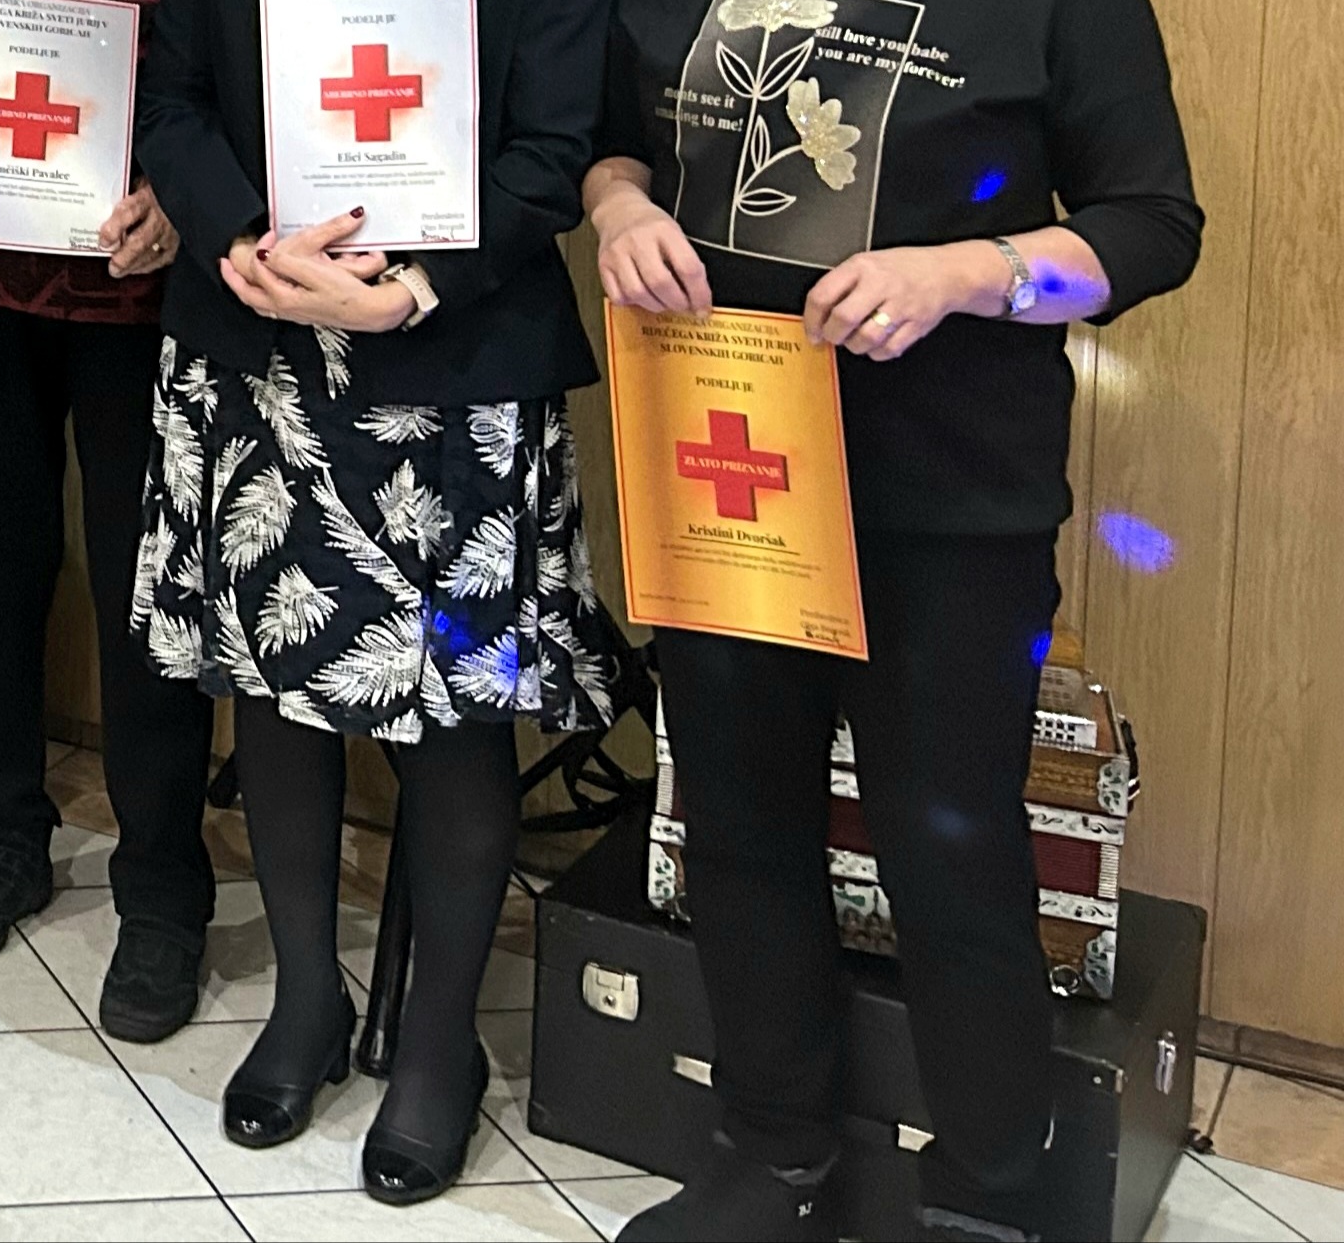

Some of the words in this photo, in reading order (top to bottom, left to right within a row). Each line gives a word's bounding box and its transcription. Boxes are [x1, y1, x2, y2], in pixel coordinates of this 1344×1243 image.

[876, 38, 907, 53] you
[911, 43, 949, 63] babe
[815, 46, 843, 61] you
[847, 52, 872, 65] are
[875, 58, 900, 73] my
[904, 61, 965, 88] forever!
[701, 94, 722, 106] see
[724, 94, 736, 109] it
[702, 113, 715, 127] to
[718, 118, 744, 132] me!
[696, 332, 729, 344] KRIŽA
[660, 343, 730, 359] SLOVENSKIH
[732, 351, 784, 365] GORICAH
[696, 376, 754, 393] PODELJUJE
[684, 455, 720, 468] ZLATO
[722, 460, 782, 479] PRIZNANJE
[688, 523, 734, 539] Kristini
